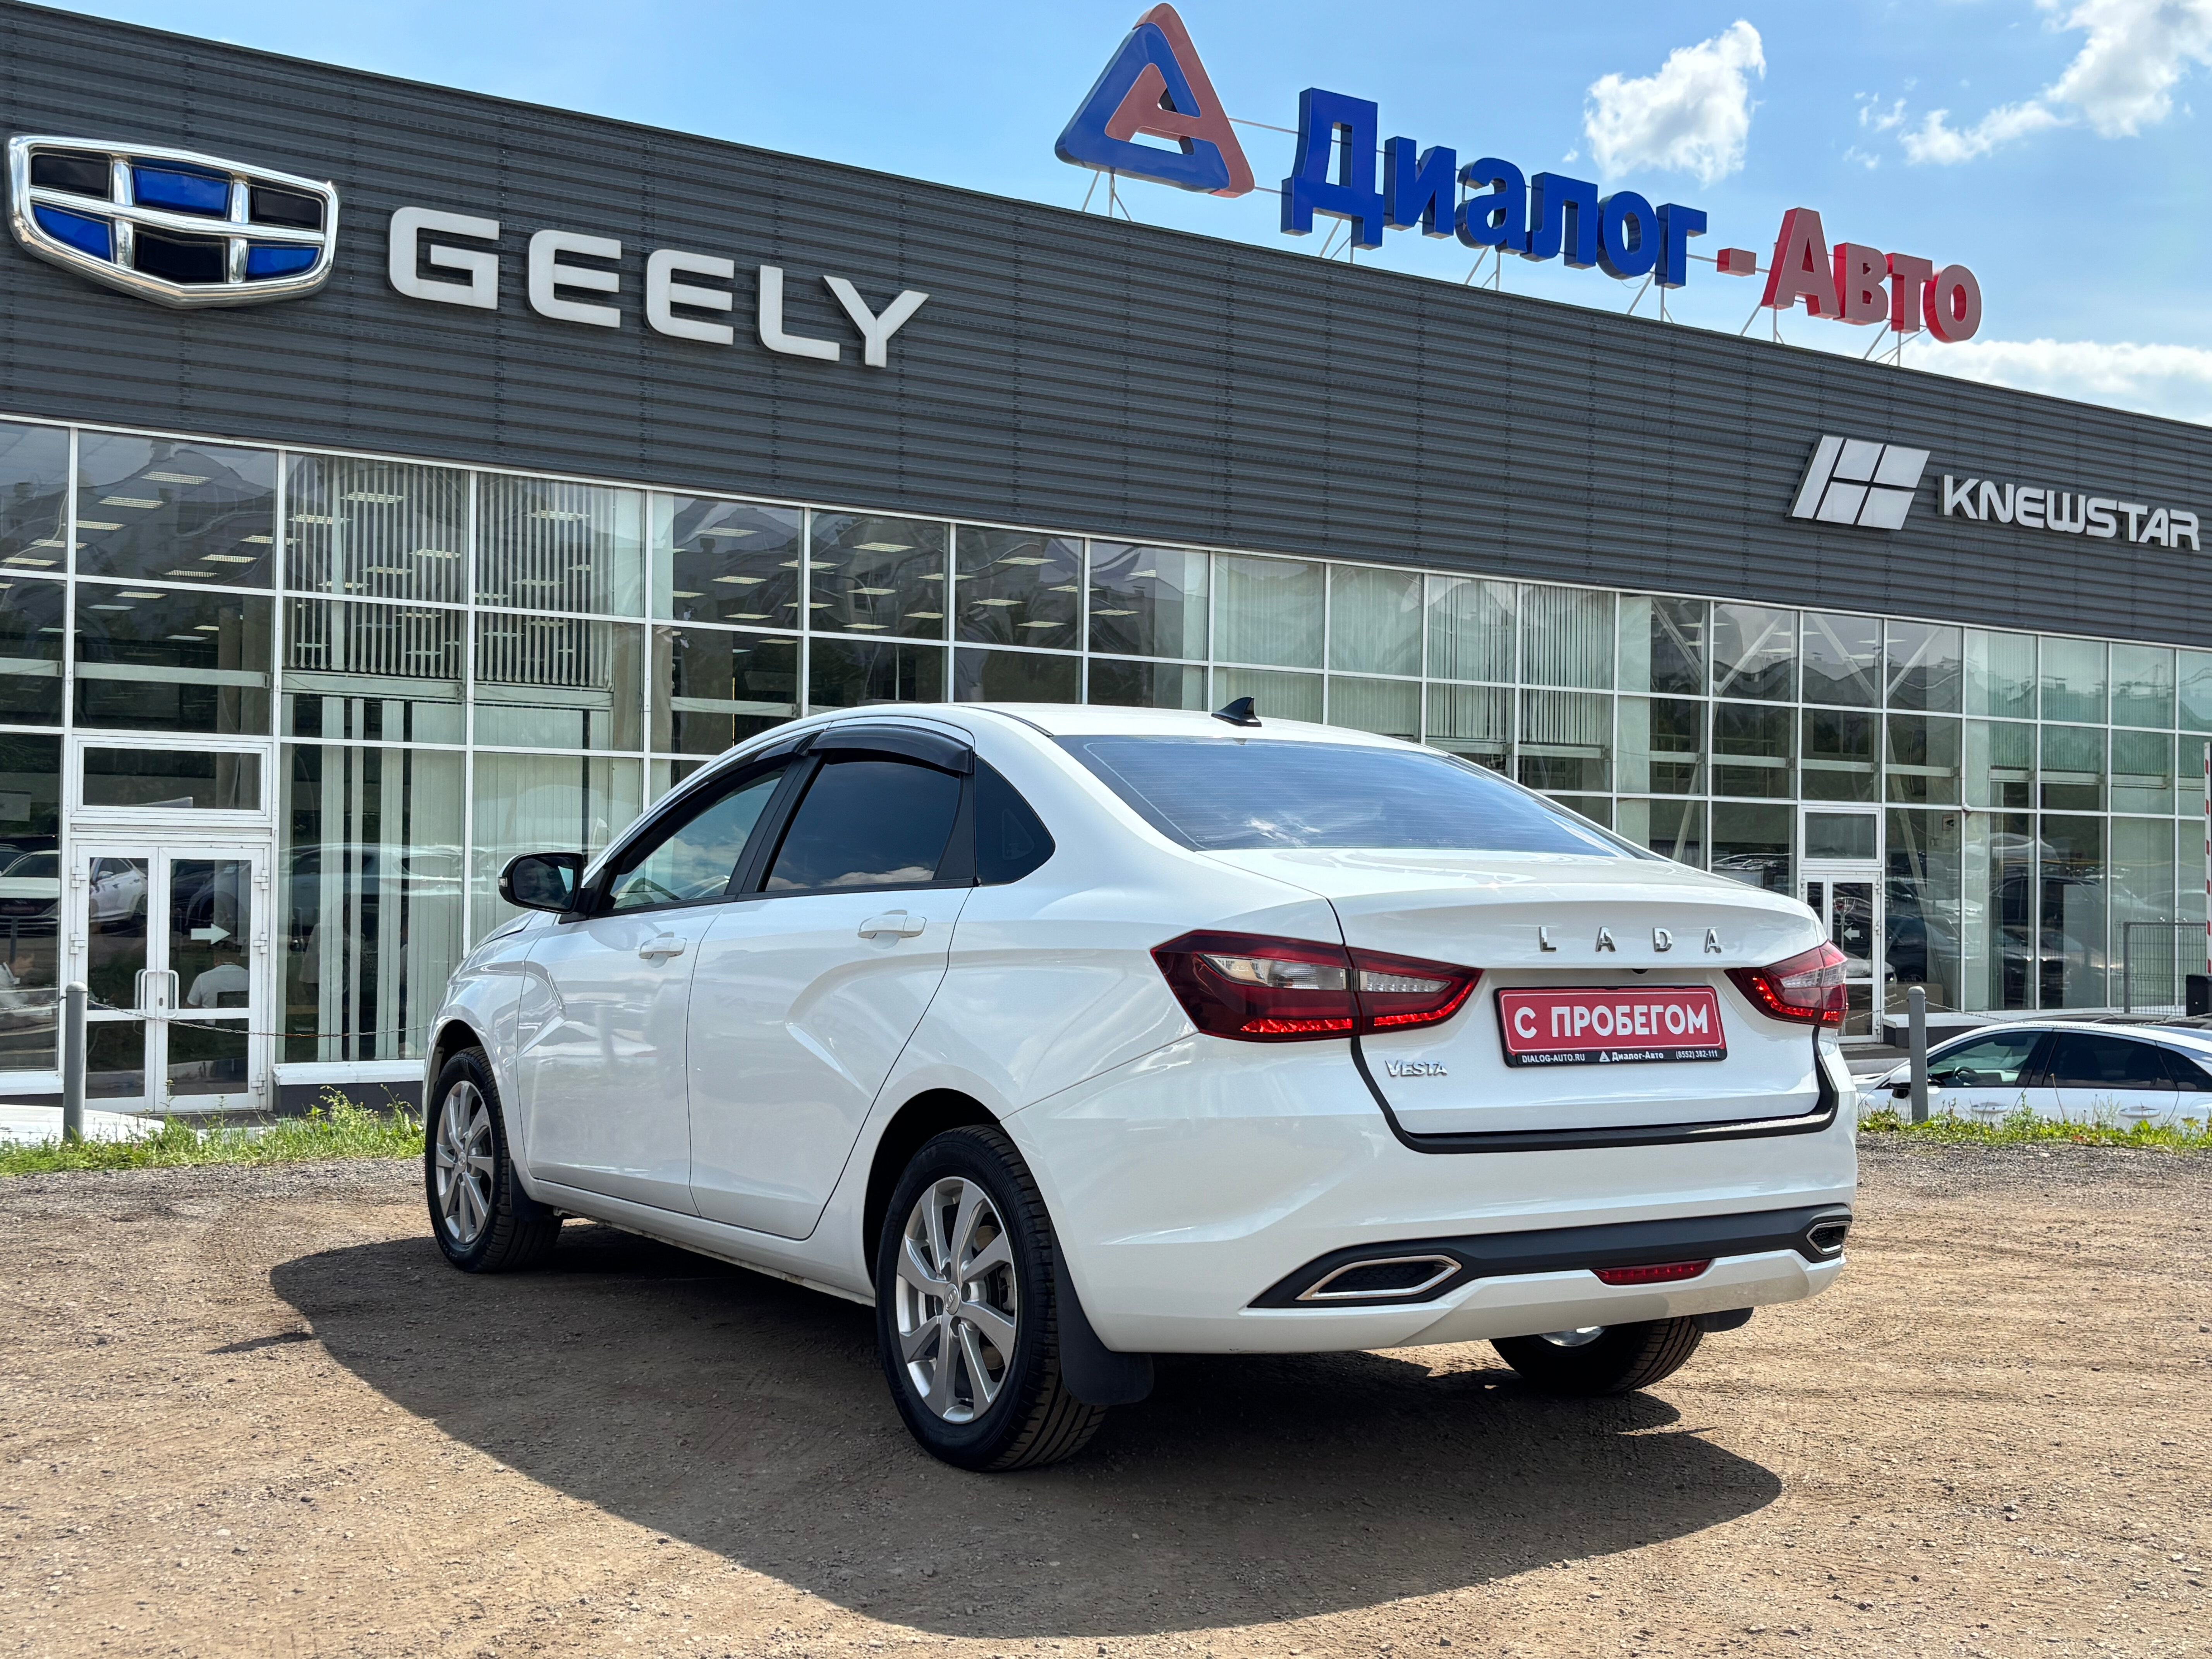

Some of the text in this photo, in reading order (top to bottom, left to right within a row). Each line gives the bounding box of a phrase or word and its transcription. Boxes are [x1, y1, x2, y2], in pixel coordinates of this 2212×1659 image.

[389, 206, 929, 368] GEELY
[1944, 474, 2200, 551] KNEWSTAR
[1539, 926, 1722, 953] LADA
[1514, 1004, 1708, 1039] С ПРОБЕГОМ
[1522, 1053, 1585, 1063] DIALOG-AUTO.RU
[1612, 1051, 1664, 1062] Диалог-Авто
[1675, 1050, 1718, 1060] (8552) 382-111
[1385, 1060, 1448, 1077] VESTA
